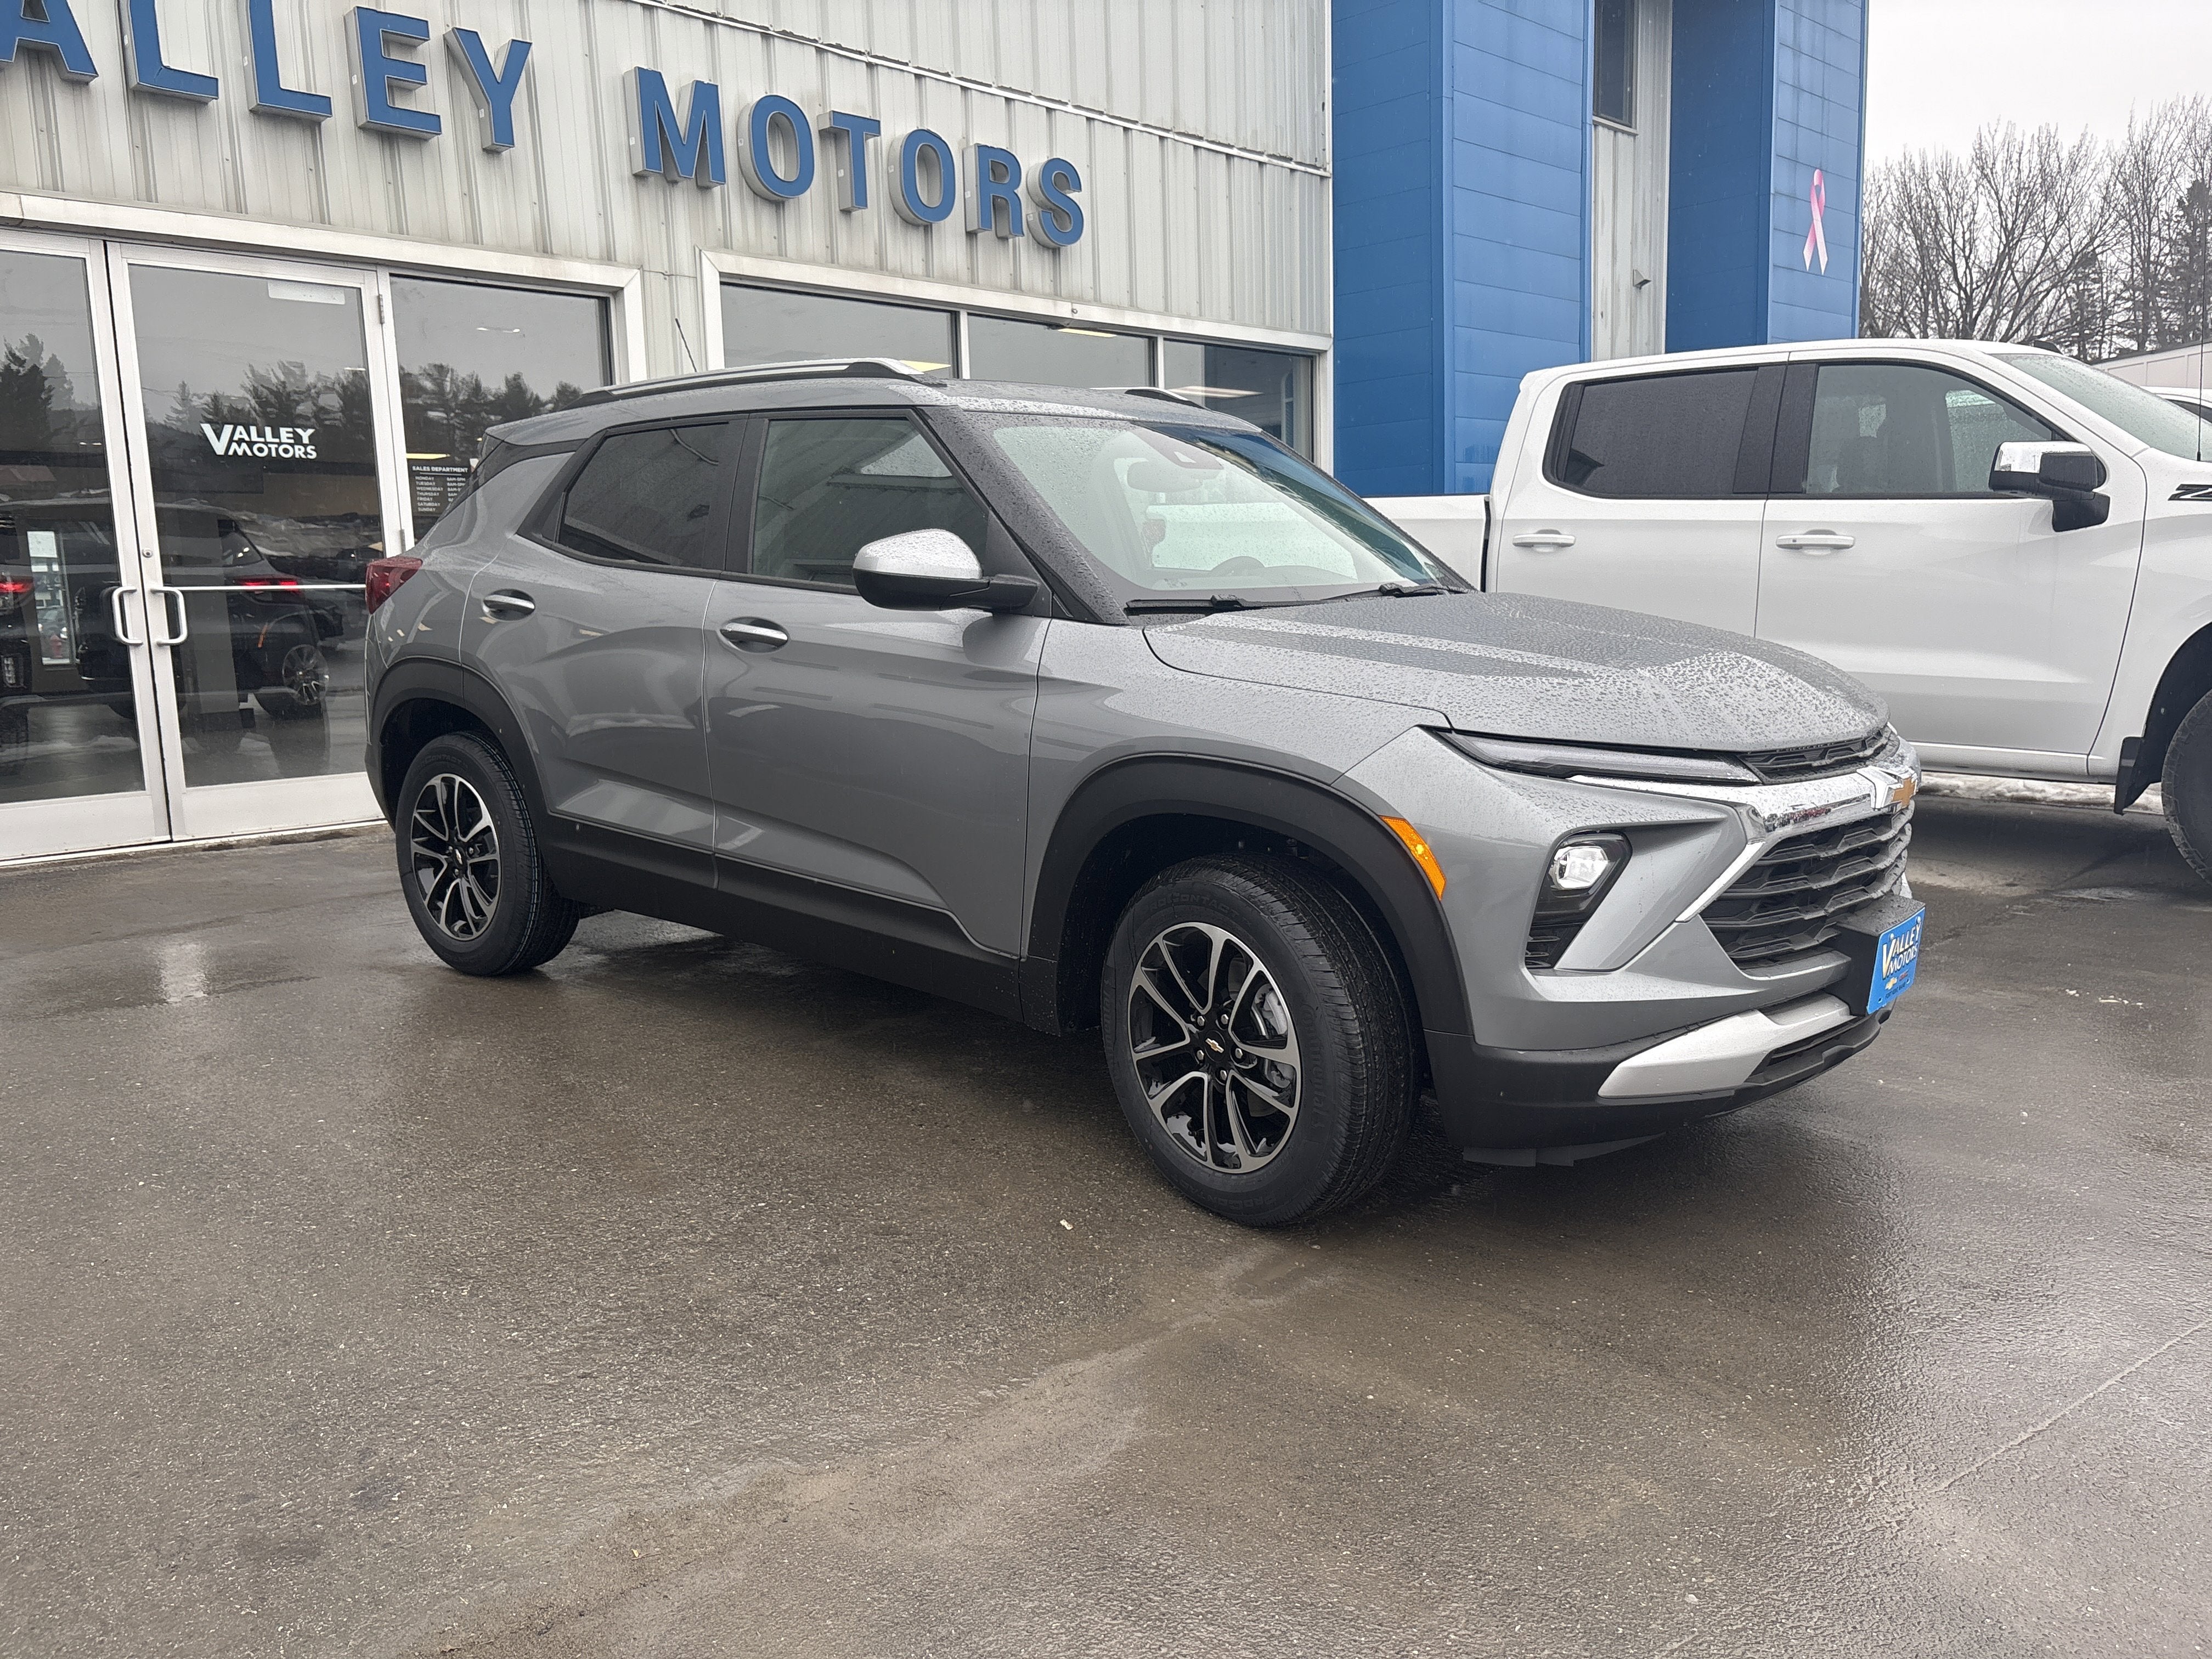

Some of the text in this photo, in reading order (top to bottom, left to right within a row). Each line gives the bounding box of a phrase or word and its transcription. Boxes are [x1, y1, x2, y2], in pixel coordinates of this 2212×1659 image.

[624, 66, 1085, 249] MOTORS
[200, 423, 315, 455] VALLEY
[228, 442, 317, 459] MOTORS
[1882, 921, 1922, 979] VALLEY
[1887, 943, 1918, 977] MOTORS
